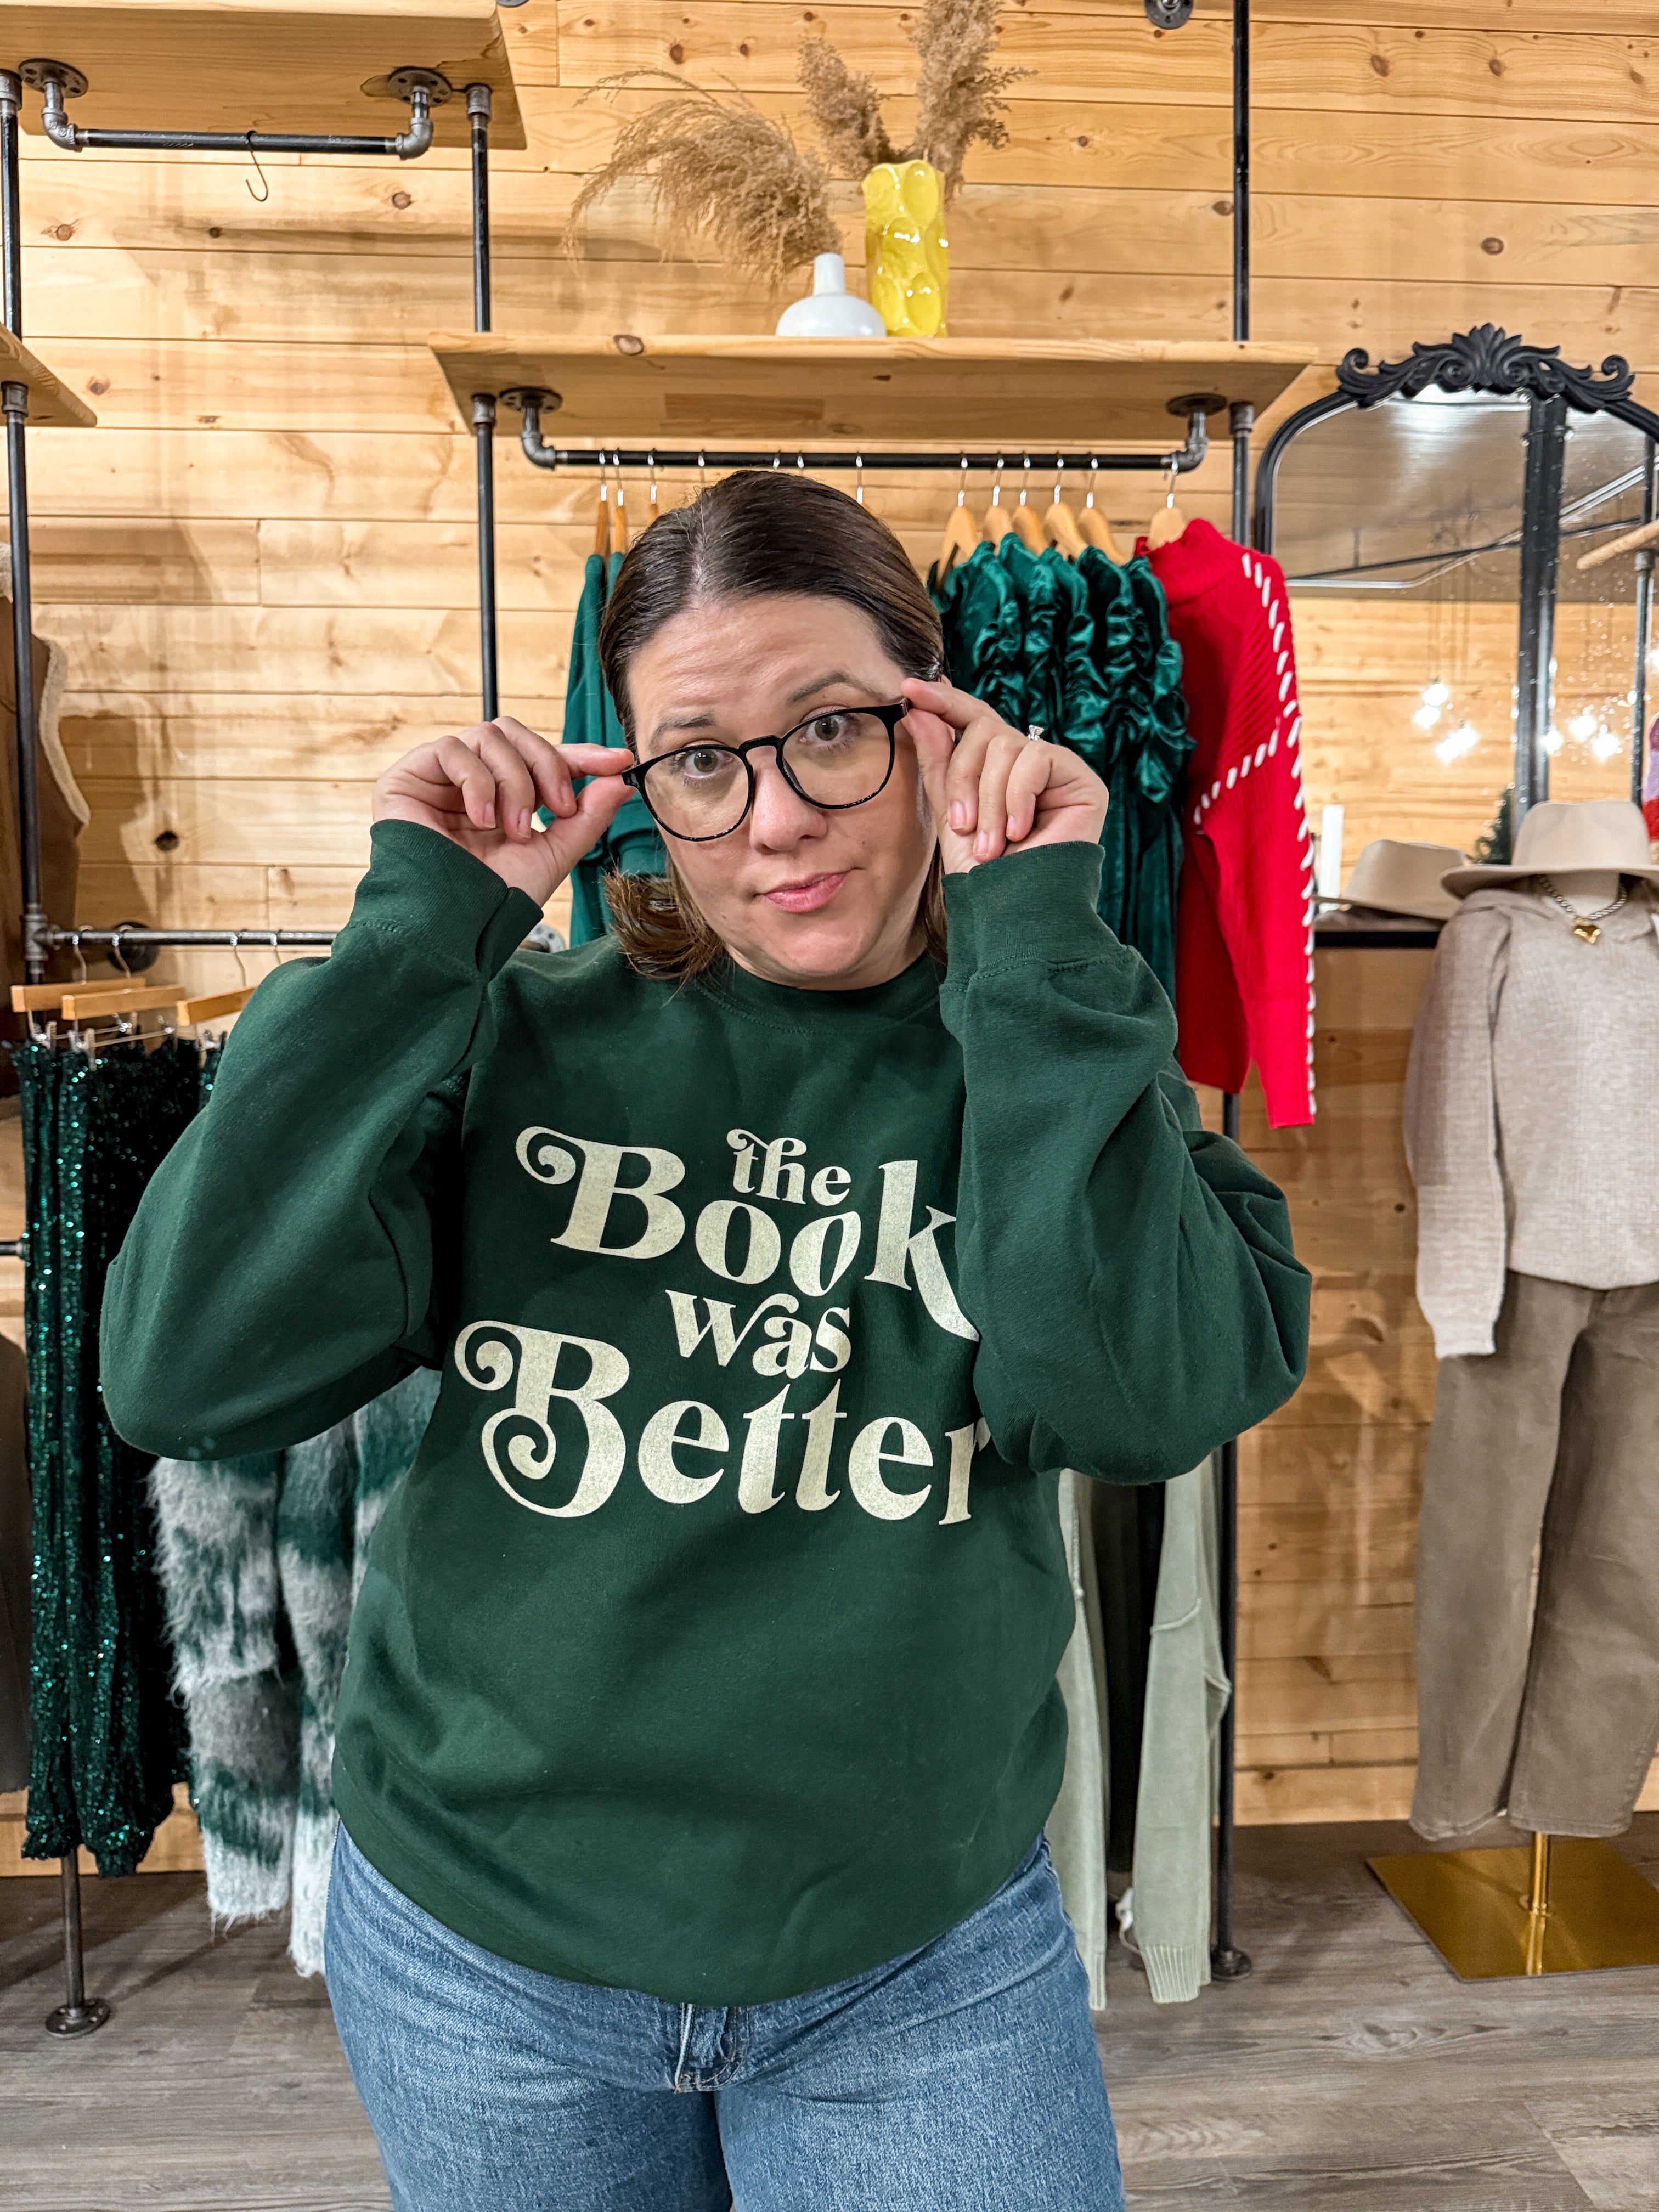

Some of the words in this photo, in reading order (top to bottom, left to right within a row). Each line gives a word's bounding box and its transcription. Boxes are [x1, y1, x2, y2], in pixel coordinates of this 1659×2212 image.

[516, 1126, 981, 1342] Book
[726, 1128, 851, 1206] the
[665, 1289, 851, 1379] was
[454, 1320, 991, 1525] Better
